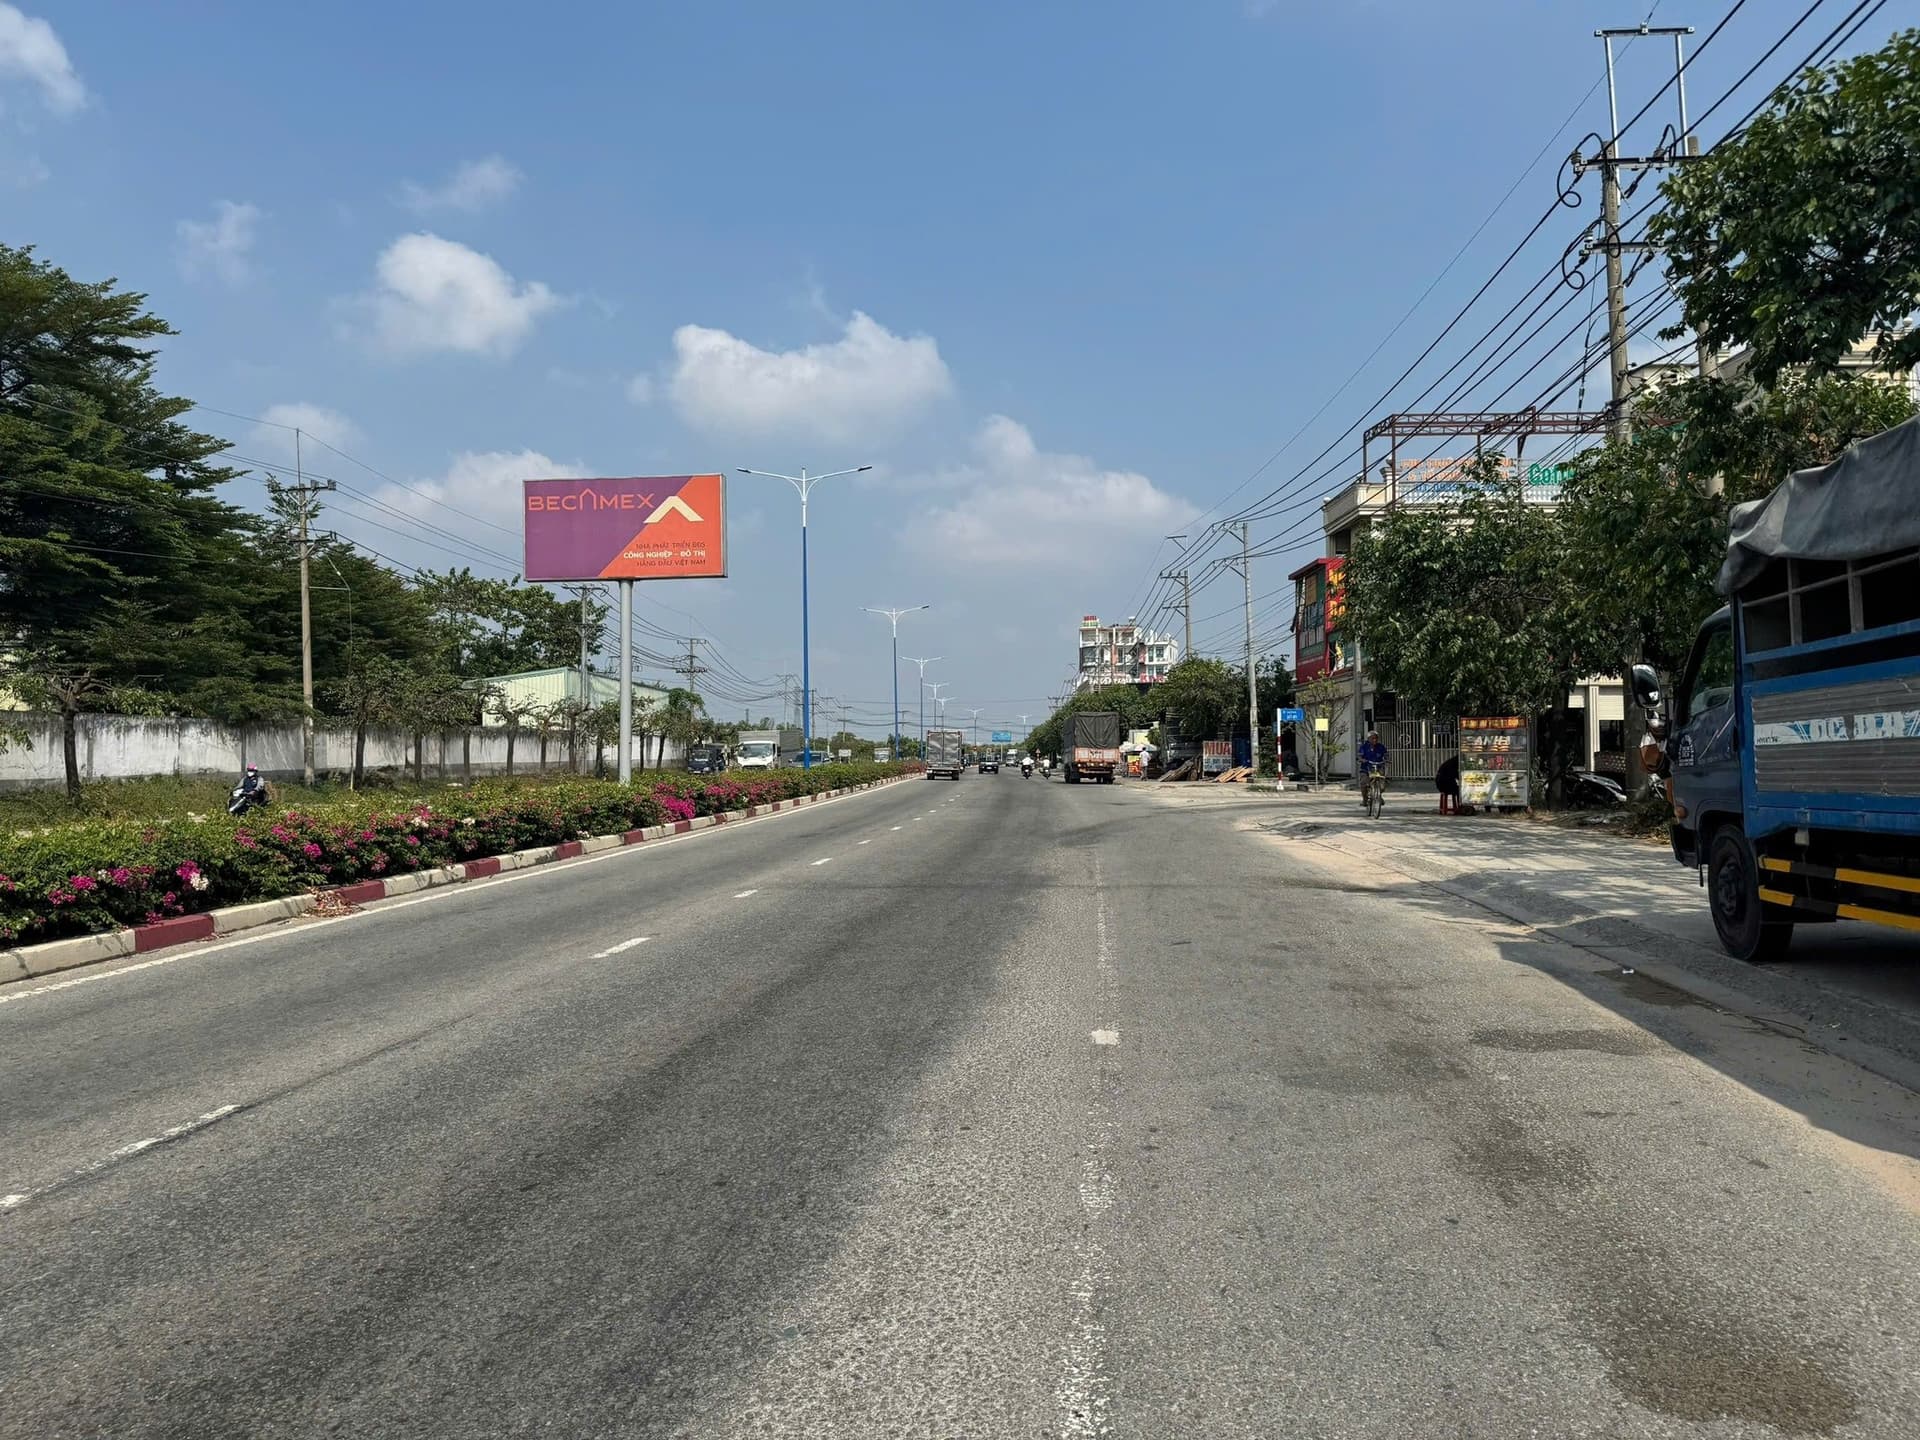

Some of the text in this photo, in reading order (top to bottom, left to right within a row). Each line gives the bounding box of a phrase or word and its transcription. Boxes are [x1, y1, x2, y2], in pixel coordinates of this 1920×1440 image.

[528, 488, 655, 511] BECAMEX
[623, 550, 644, 559] CÔNG
[646, 550, 673, 559] NGHIỆP
[1204, 742, 1231, 755] MUA
